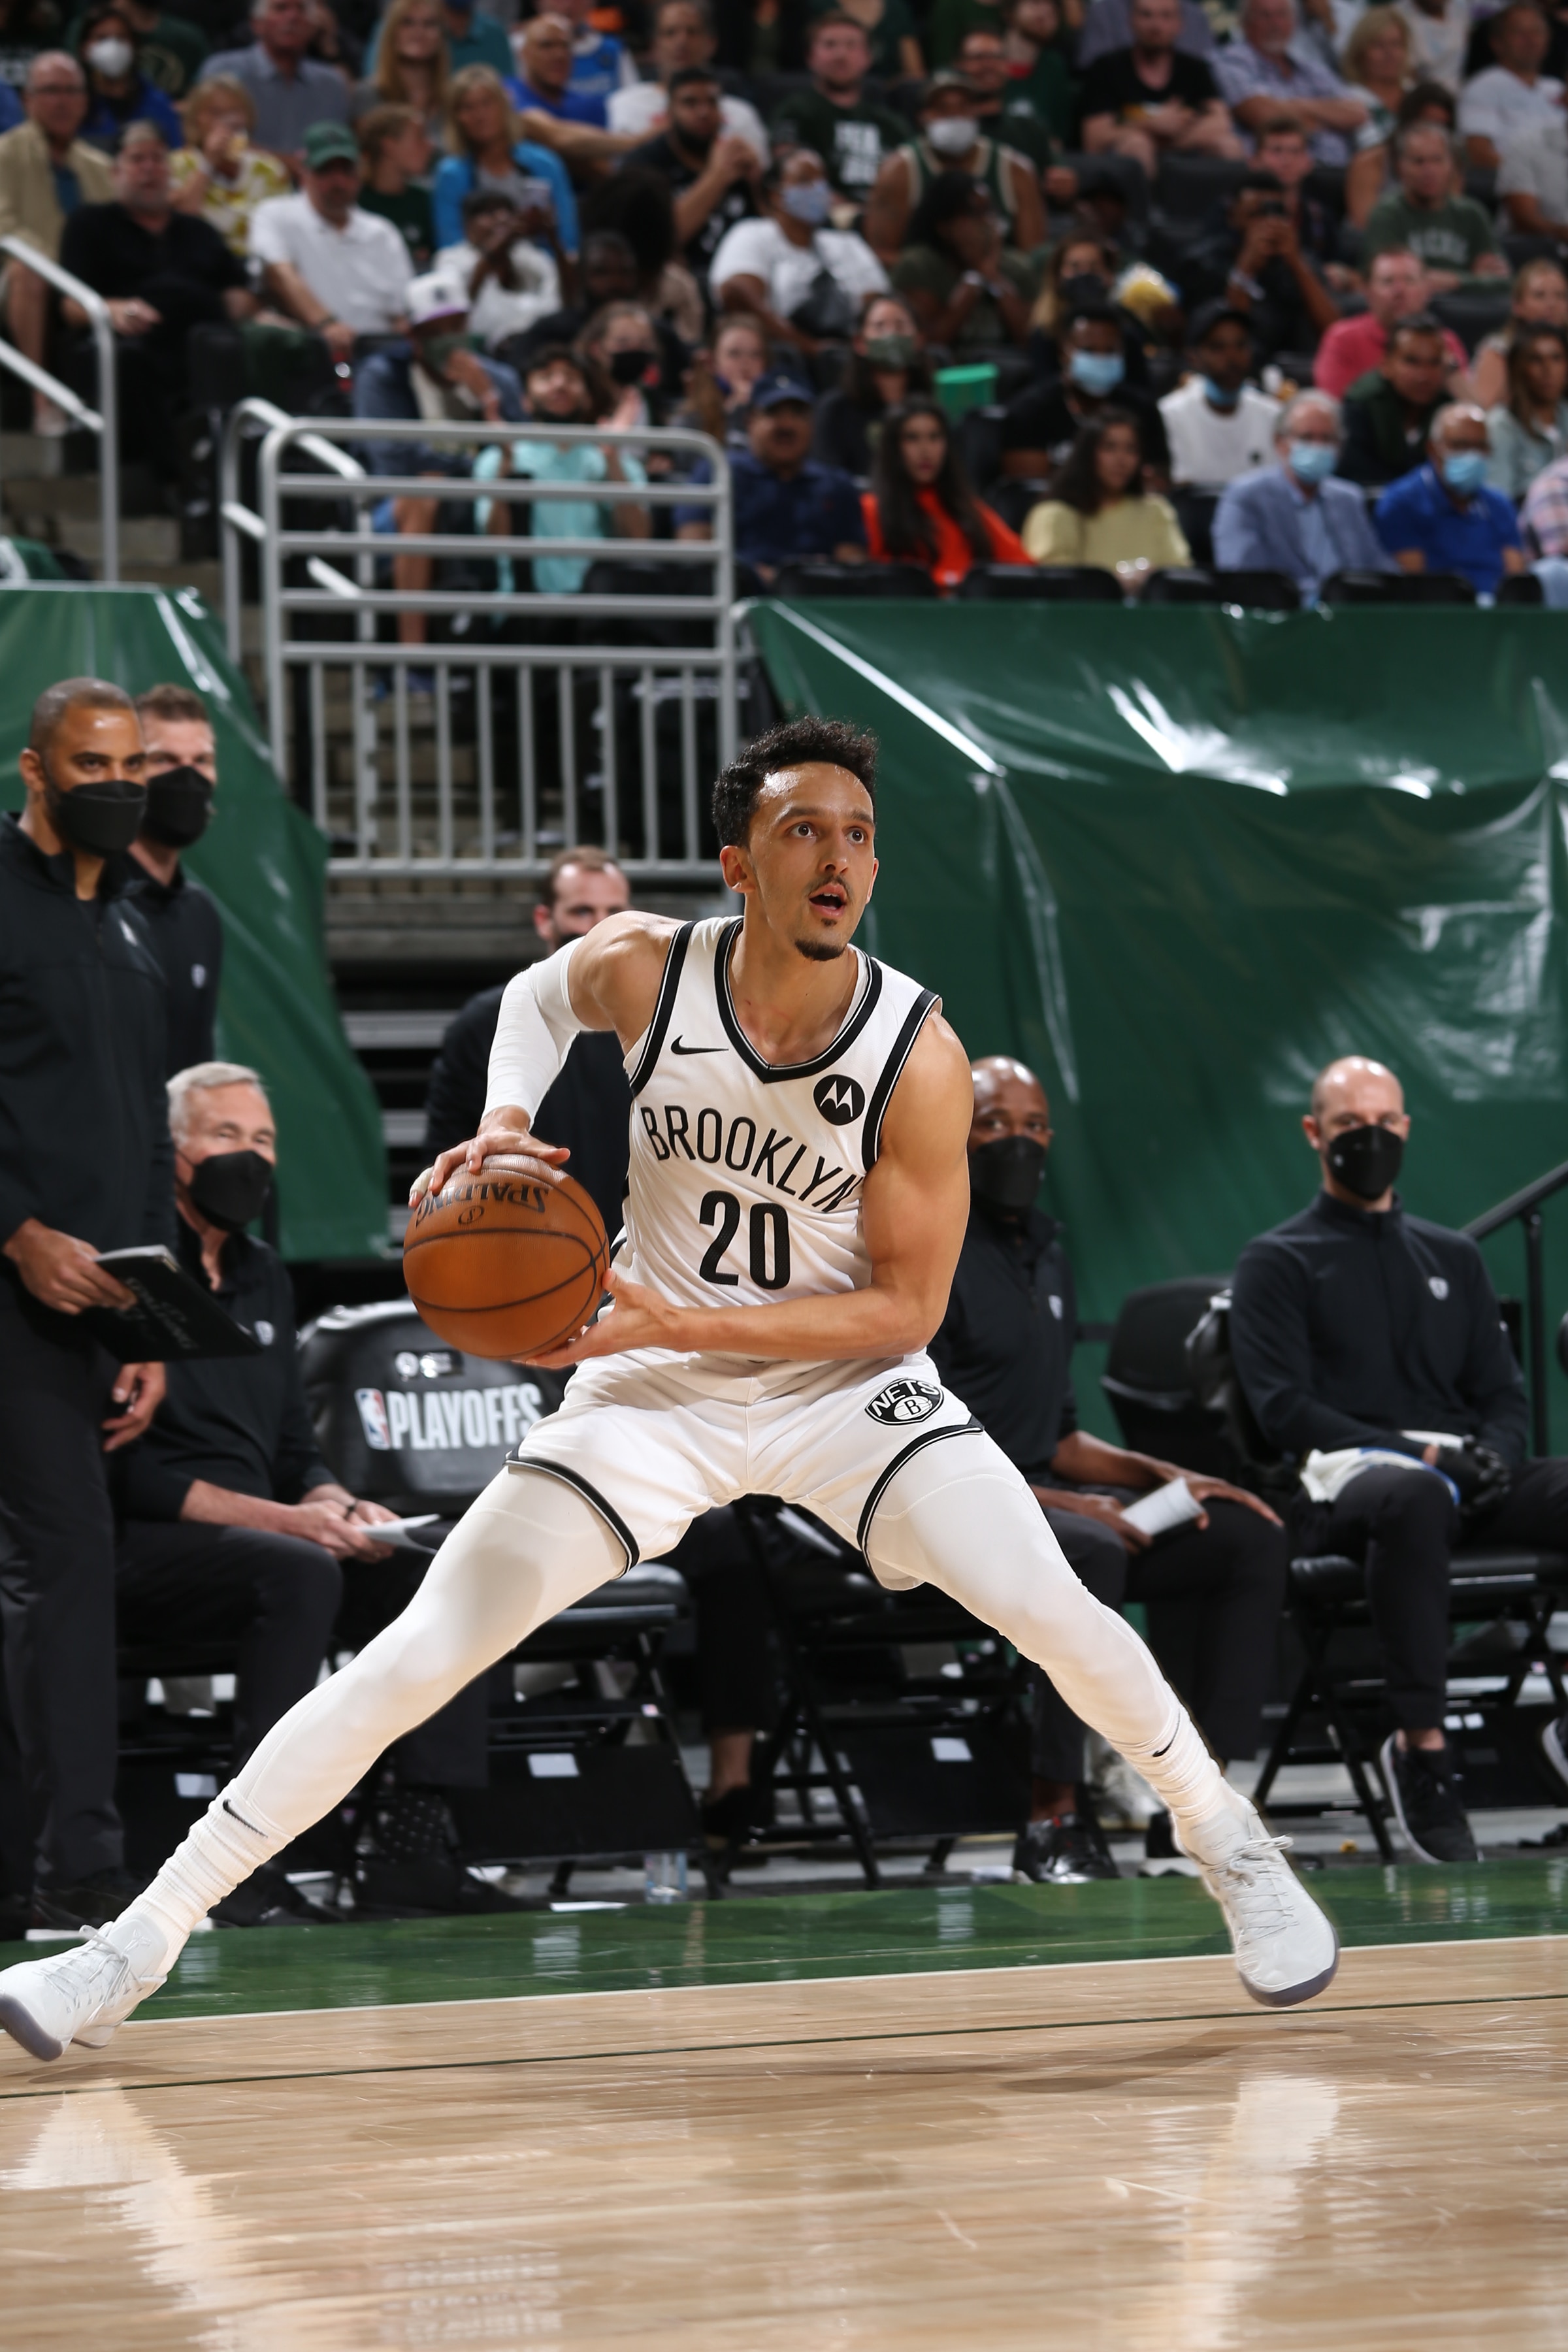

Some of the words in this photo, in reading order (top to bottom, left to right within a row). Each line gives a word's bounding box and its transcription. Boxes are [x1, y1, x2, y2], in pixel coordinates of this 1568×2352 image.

[640, 1105, 864, 1213] BROOKLYN
[415, 1183, 550, 1228] SPALDING
[699, 1190, 791, 1290] 20
[385, 1382, 542, 1450] PLAYOFFS
[871, 1380, 939, 1417] NETS
[904, 1399, 921, 1415] B
